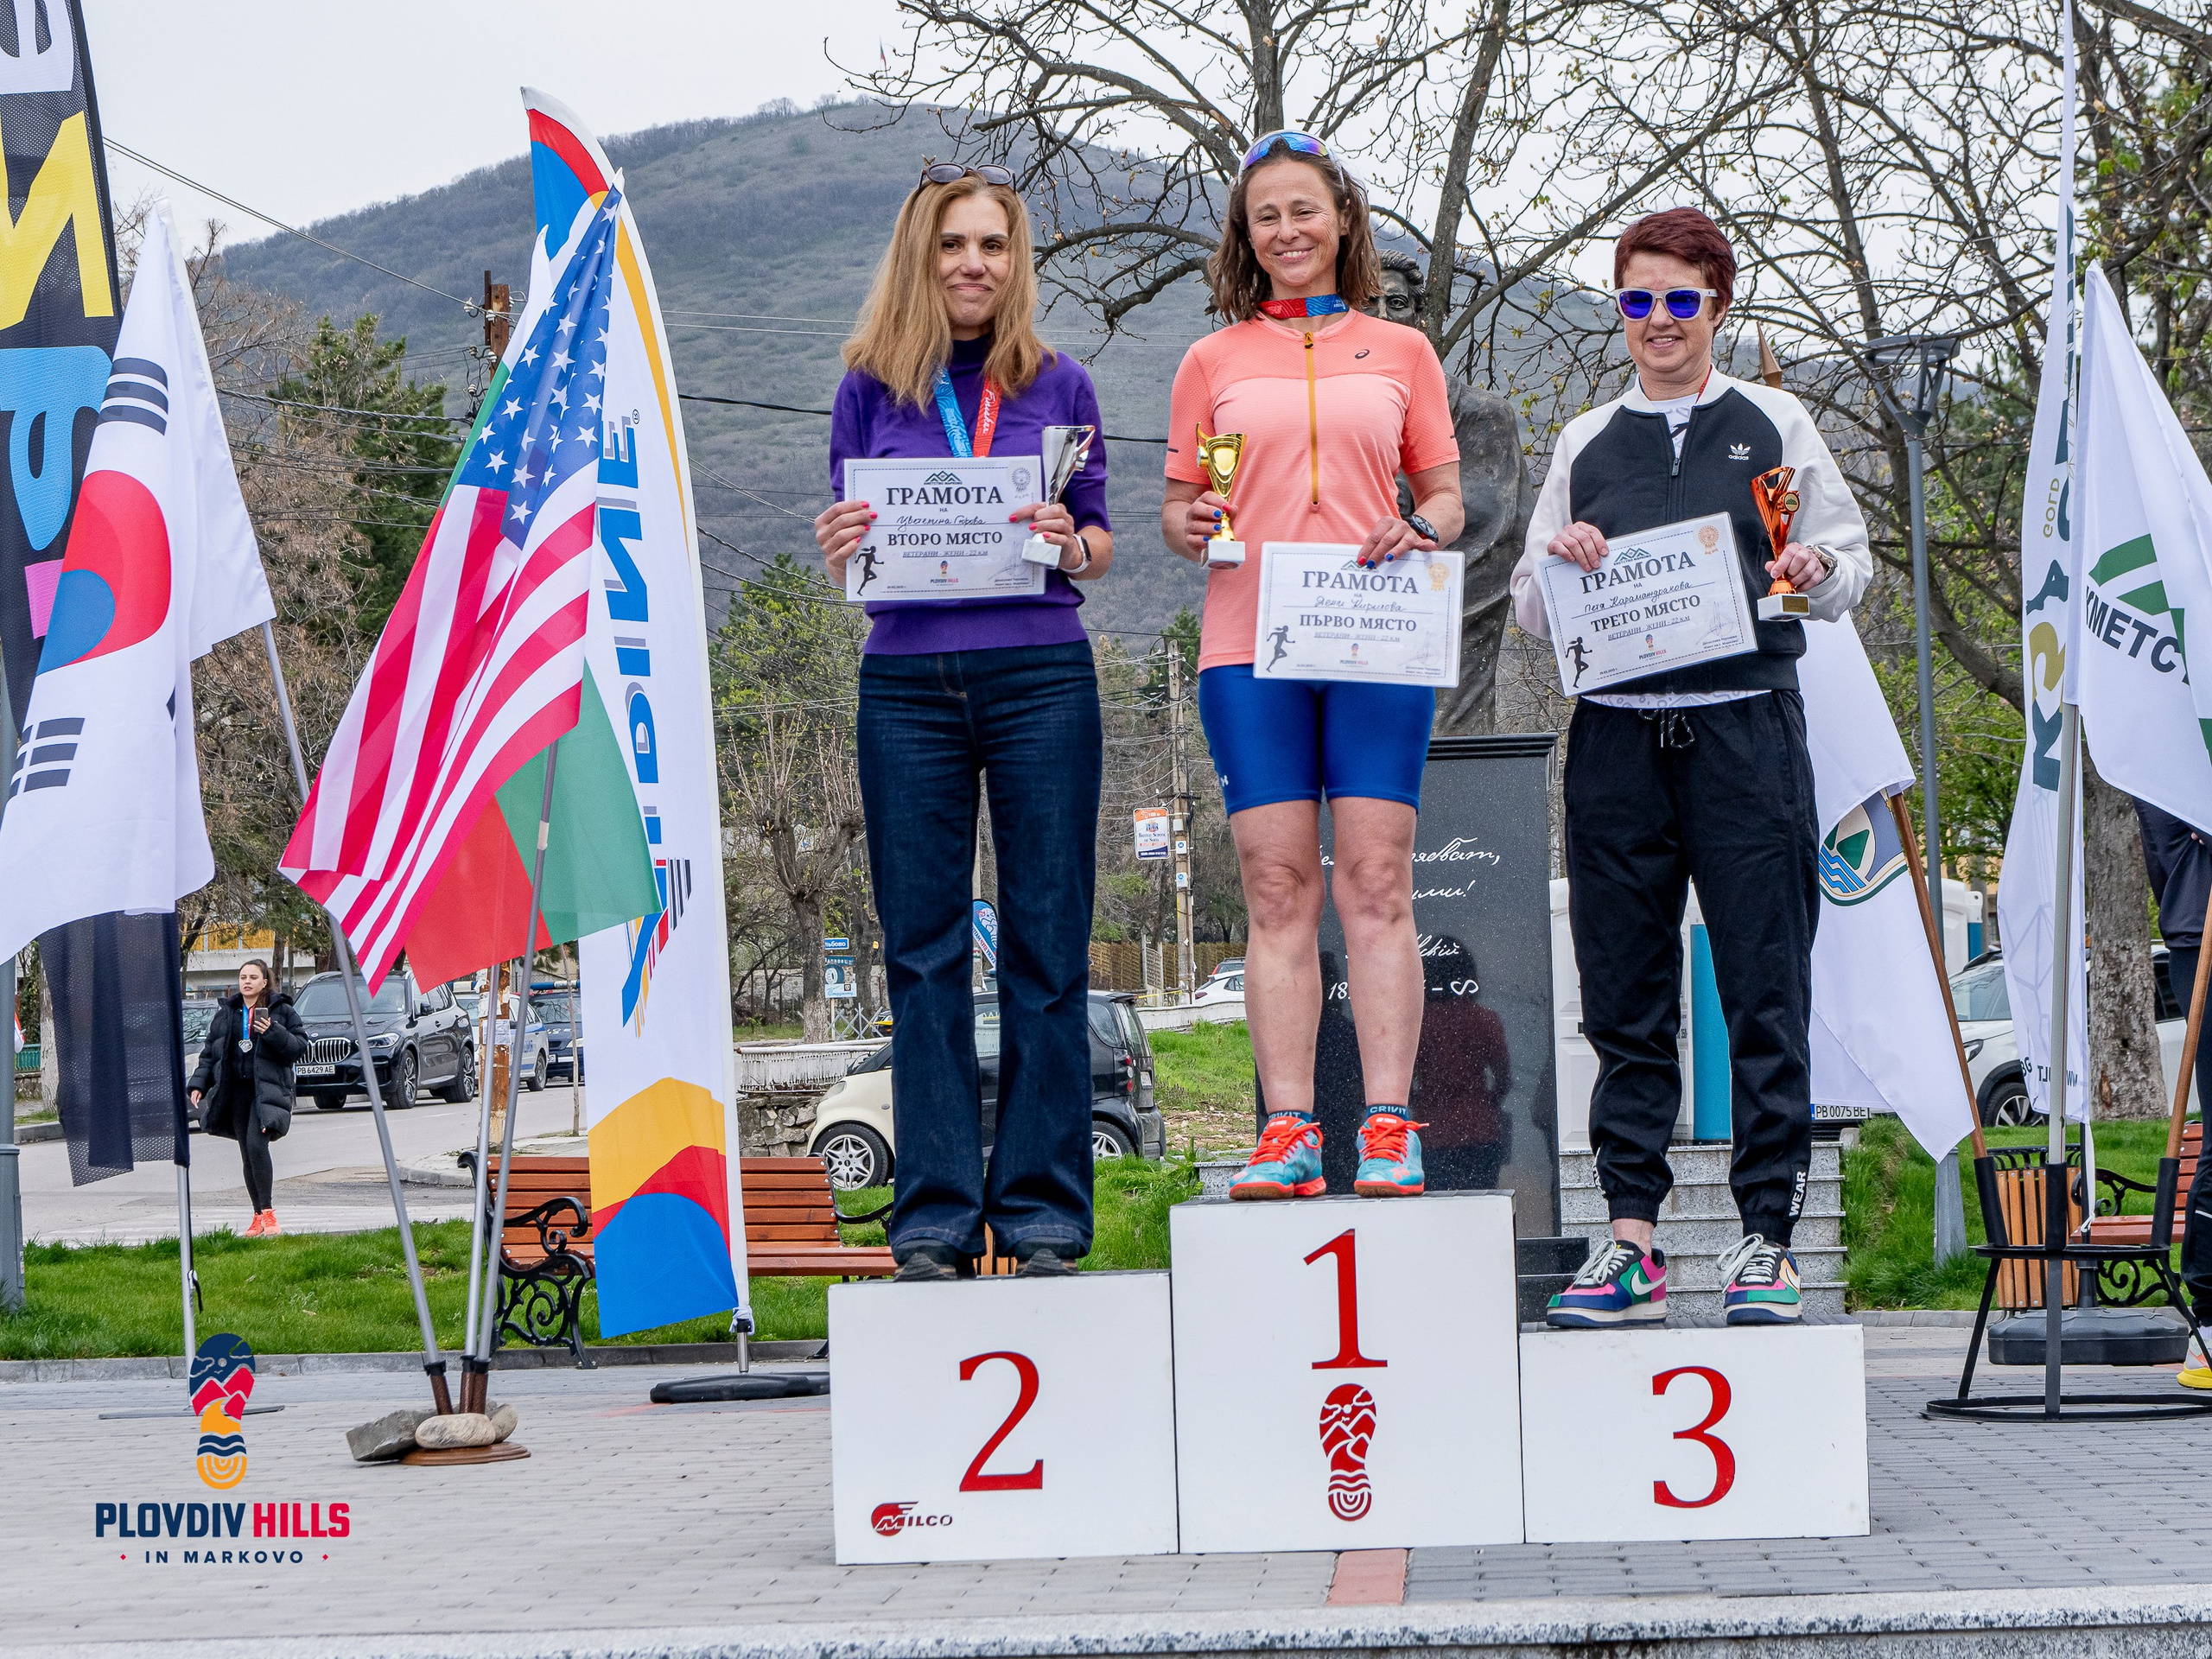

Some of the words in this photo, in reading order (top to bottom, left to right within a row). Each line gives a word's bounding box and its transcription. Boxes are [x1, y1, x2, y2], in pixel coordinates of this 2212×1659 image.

[886, 486, 1004, 505] ГРАМОТА
[887, 533, 941, 546] ВТОРО
[946, 531, 1002, 545] МЯСТО
[1302, 570, 1419, 594] ГРАМОТА
[1580, 551, 1695, 594] ГРАМОТА
[1300, 614, 1355, 628] ПЪРВО
[1359, 617, 1417, 632] МЯСТО
[1591, 609, 1640, 632] ТРЕТО
[1643, 594, 1700, 619] МЯСТО
[2086, 585, 2190, 685] КМЕТС
[1370, 1106, 1407, 1115] CRIVIT
[1815, 1106, 1828, 1118] PB
[1829, 1106, 1852, 1117] 0075
[1853, 1107, 1866, 1116] BE
[1789, 1171, 1807, 1217] WEAR
[1303, 1227, 1389, 1370] 1
[958, 1350, 1044, 1492] 2
[1650, 1365, 1736, 1509] 3
[874, 1512, 953, 1532] MILCO
